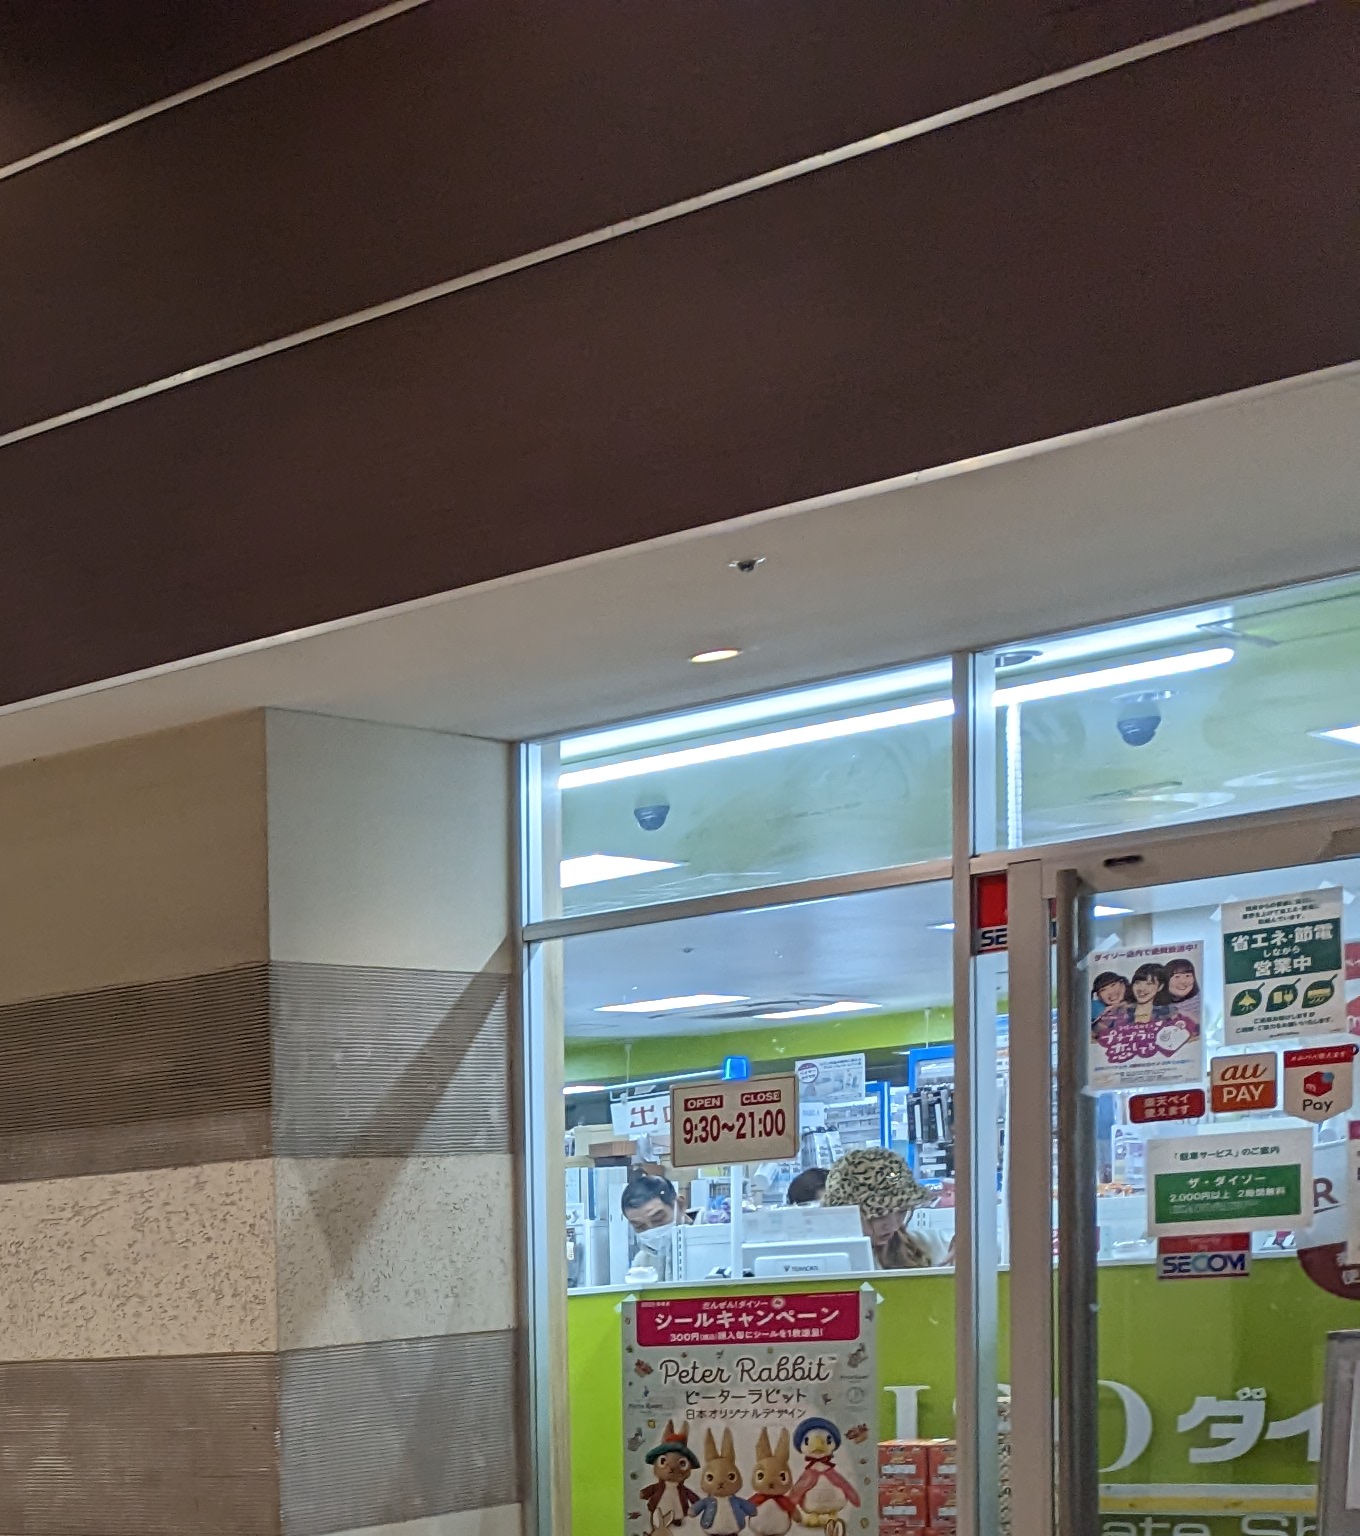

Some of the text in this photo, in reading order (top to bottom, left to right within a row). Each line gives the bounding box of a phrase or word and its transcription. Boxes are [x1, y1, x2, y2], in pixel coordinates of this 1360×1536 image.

[1231, 923, 1333, 952] 省エネ・節電
[1253, 955, 1312, 977] 営業中
[1220, 1063, 1267, 1082] au
[687, 1091, 781, 1109] OPEN CLOSE
[1223, 1084, 1264, 1103] PAY
[1302, 1099, 1334, 1113] Pay
[630, 1104, 671, 1129] 出
[1162, 1253, 1246, 1274] SECOM
[655, 1307, 840, 1331] シールキャンペーン
[659, 1355, 831, 1385] Peter Rabbit
[685, 1388, 808, 1405] ピーターラビット
[686, 1408, 807, 1420] 日本オリジナルデザイン
